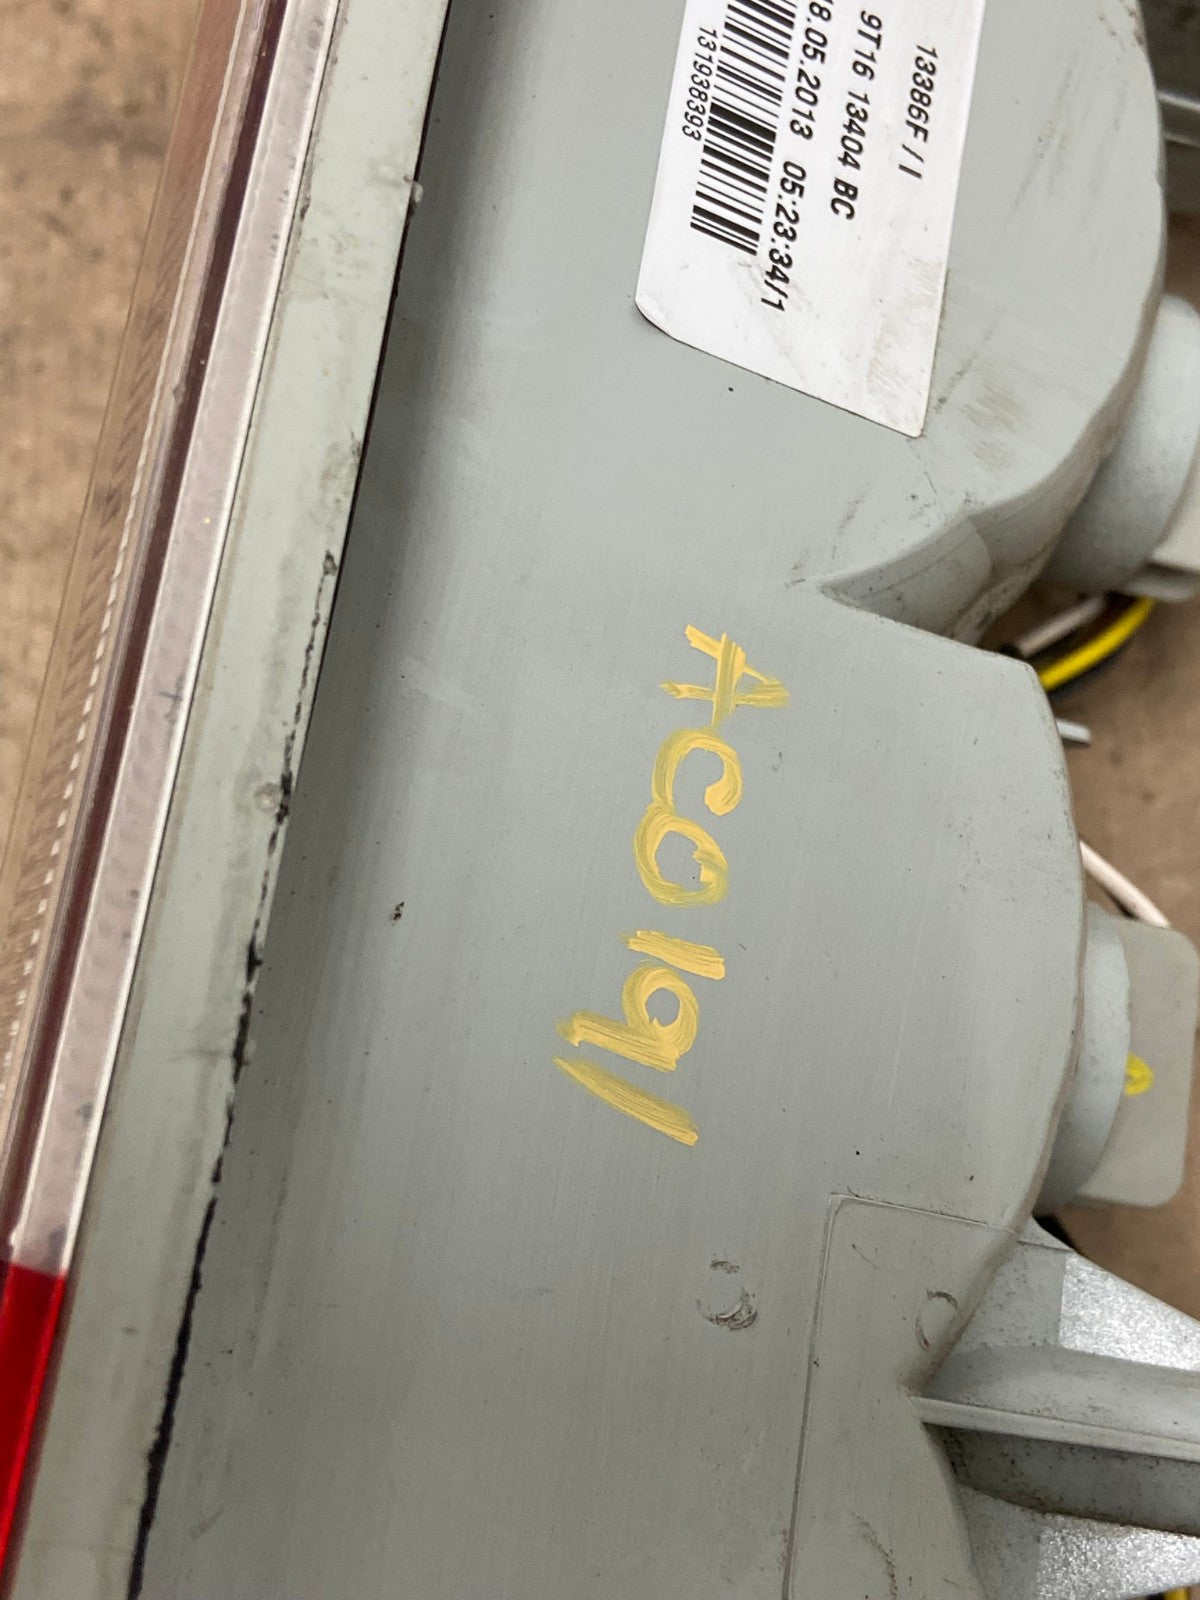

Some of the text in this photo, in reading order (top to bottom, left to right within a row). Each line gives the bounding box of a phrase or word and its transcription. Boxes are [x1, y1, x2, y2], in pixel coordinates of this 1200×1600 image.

[681, 26, 718, 141] 131938393
[760, 0, 834, 312] 8.05.2013 05:23:34/1
[830, 10, 883, 221] 9T16 13404 BC
[904, 44, 939, 143] 13386F
